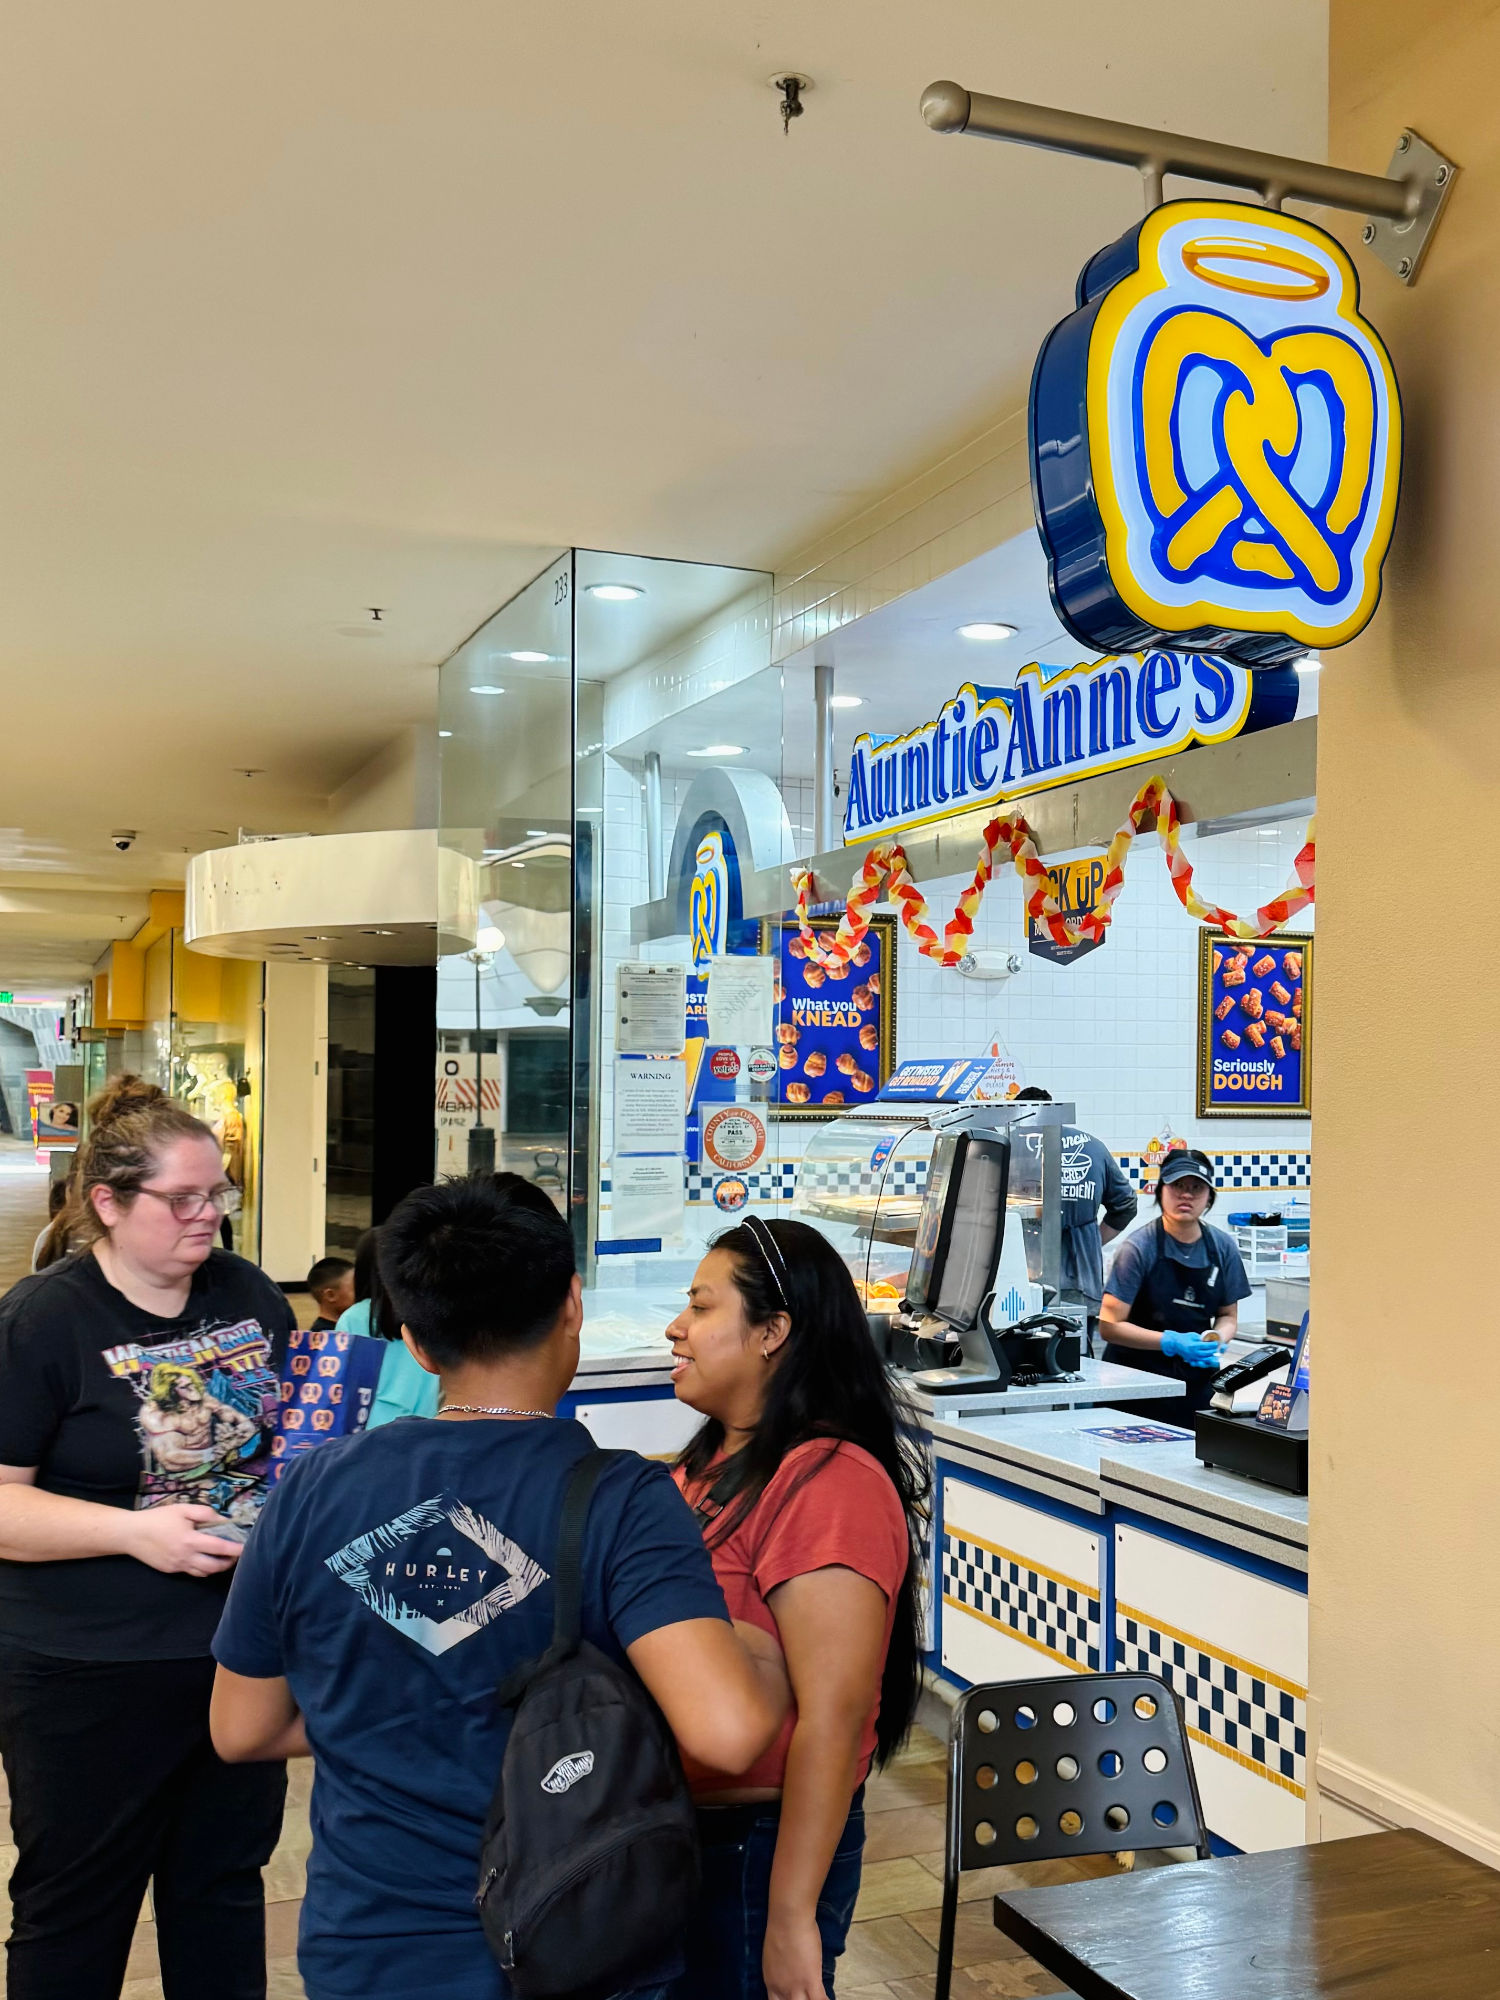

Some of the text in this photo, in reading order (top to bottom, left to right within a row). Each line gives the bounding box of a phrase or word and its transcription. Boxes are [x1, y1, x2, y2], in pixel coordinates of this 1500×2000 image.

[554, 571, 568, 606] 233
[845, 651, 1234, 831] Auntie Anne's
[717, 980, 762, 1025] SAMPLE
[792, 998, 857, 1015] What you
[792, 1009, 862, 1028] KNEAD
[630, 1072, 672, 1080] WARNING
[1213, 1058, 1276, 1076] Seriously
[1213, 1073, 1283, 1091] DOUGH
[706, 1109, 731, 1142] COUNTY
[740, 1110, 766, 1140] ORANGE
[713, 1153, 759, 1169] CALIFORNIA
[385, 1562, 487, 1584] HURLEY
